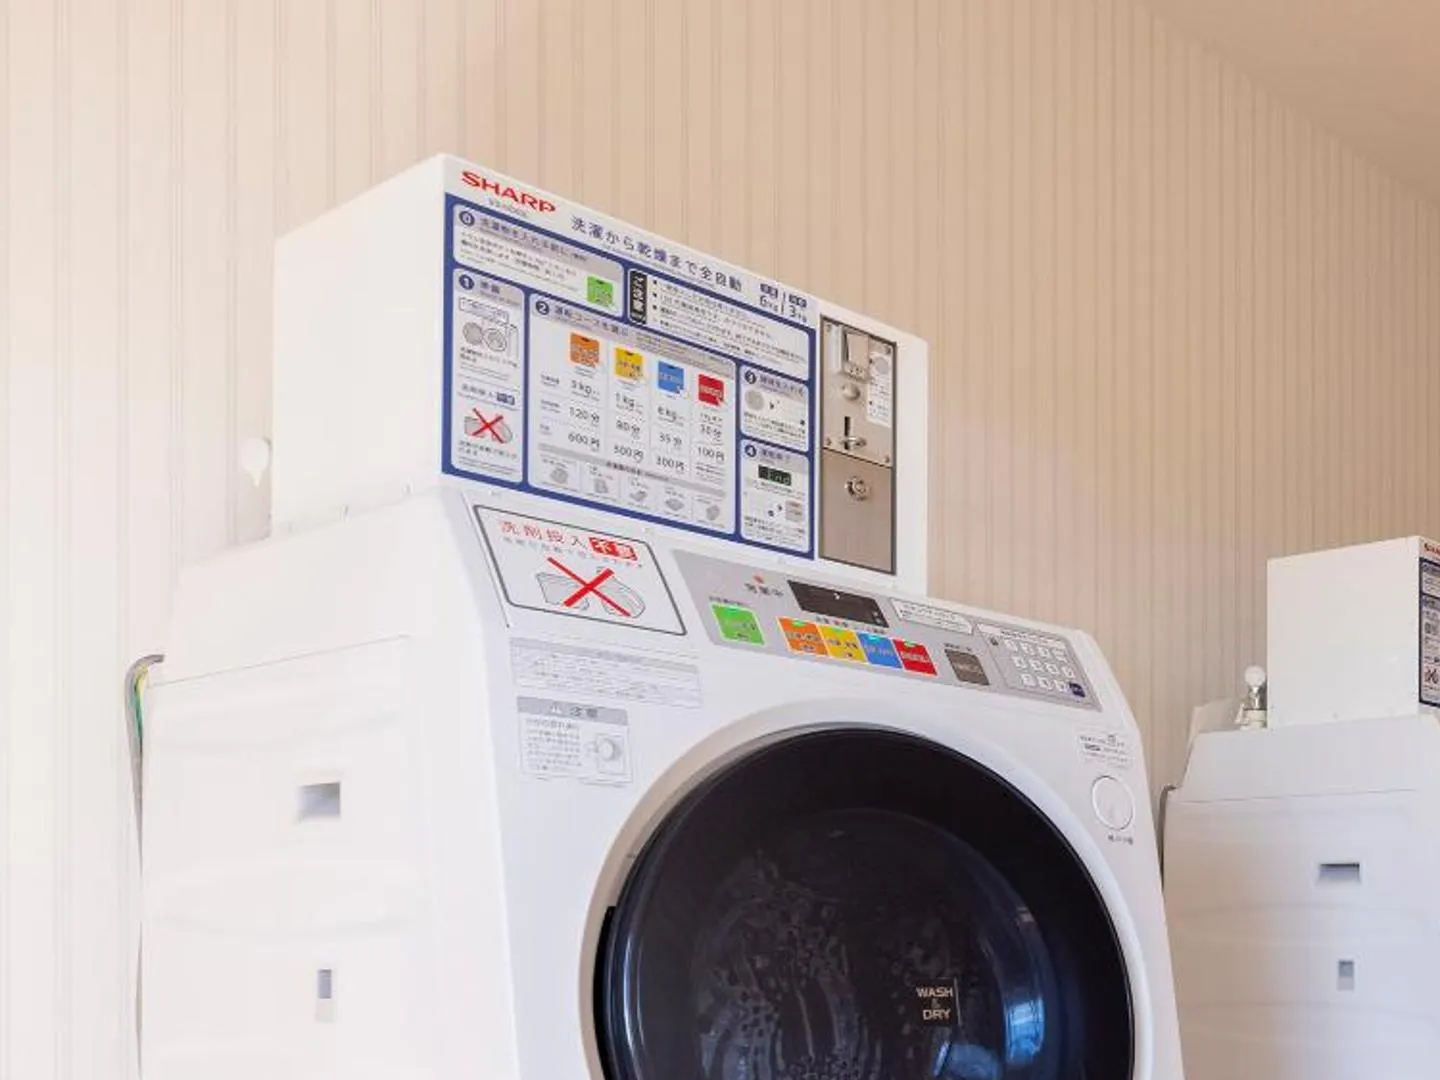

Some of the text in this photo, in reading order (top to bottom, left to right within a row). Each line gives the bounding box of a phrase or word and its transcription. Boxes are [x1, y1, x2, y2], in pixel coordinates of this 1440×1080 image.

[462, 170, 556, 213] SHARP
[916, 987, 953, 998] WASH
[922, 1008, 951, 1021] DRY
